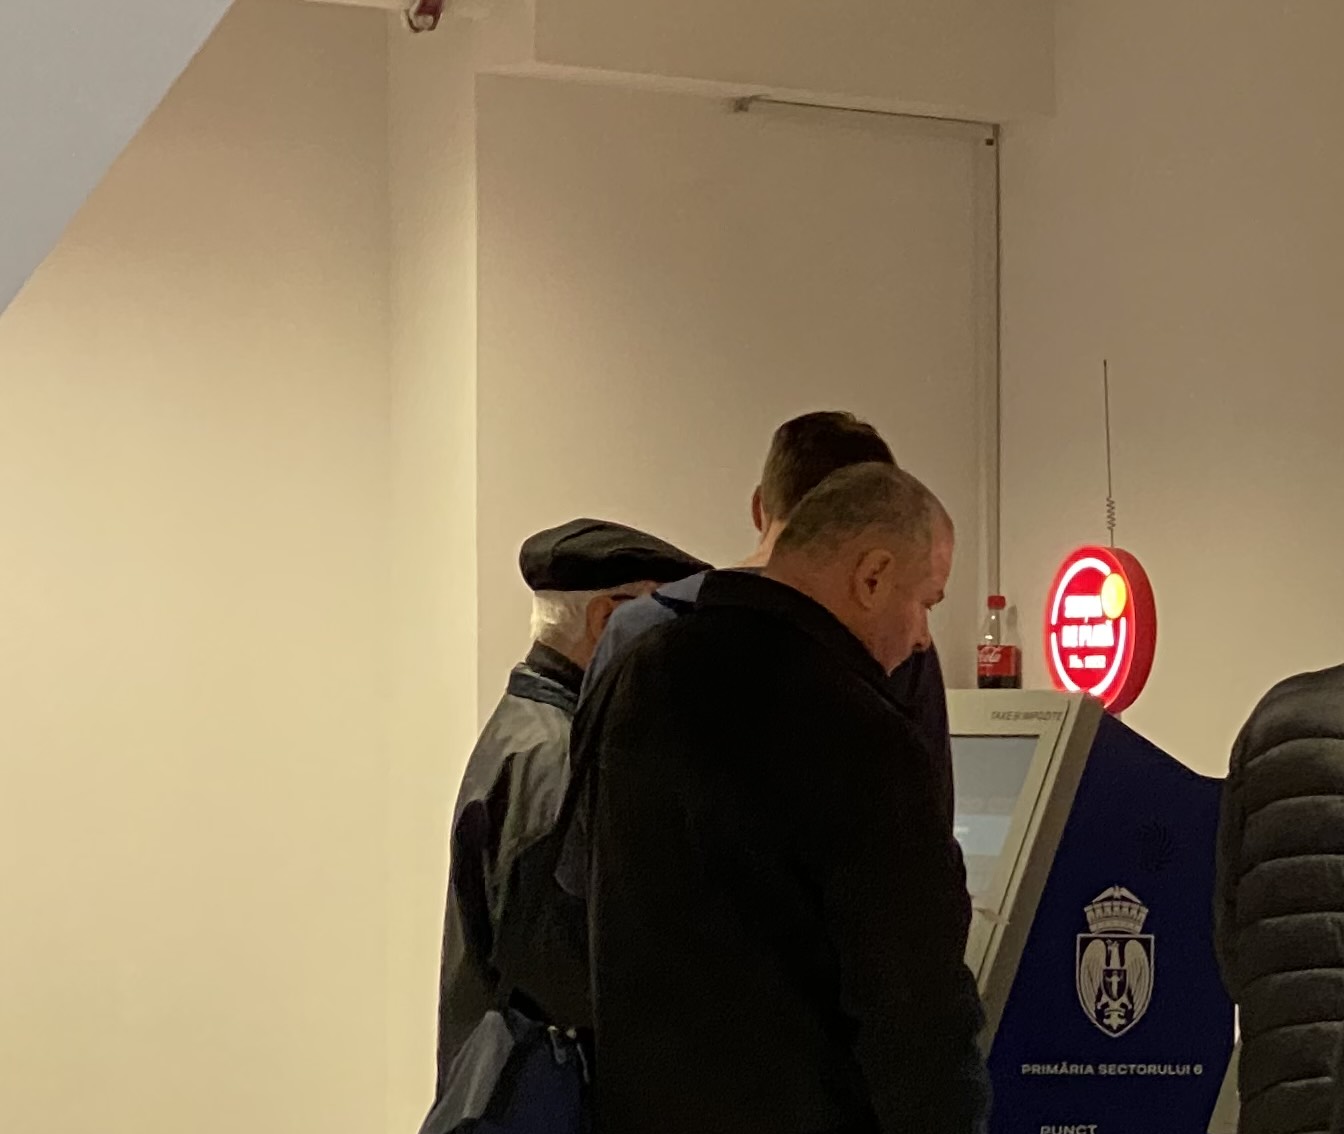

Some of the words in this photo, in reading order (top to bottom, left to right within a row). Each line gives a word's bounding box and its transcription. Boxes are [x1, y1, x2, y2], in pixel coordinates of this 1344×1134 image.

[1021, 1061, 1095, 1075] PRIMĂRIA
[1098, 1064, 1191, 1075] SECTORULUI
[1193, 1064, 1203, 1075] 6
